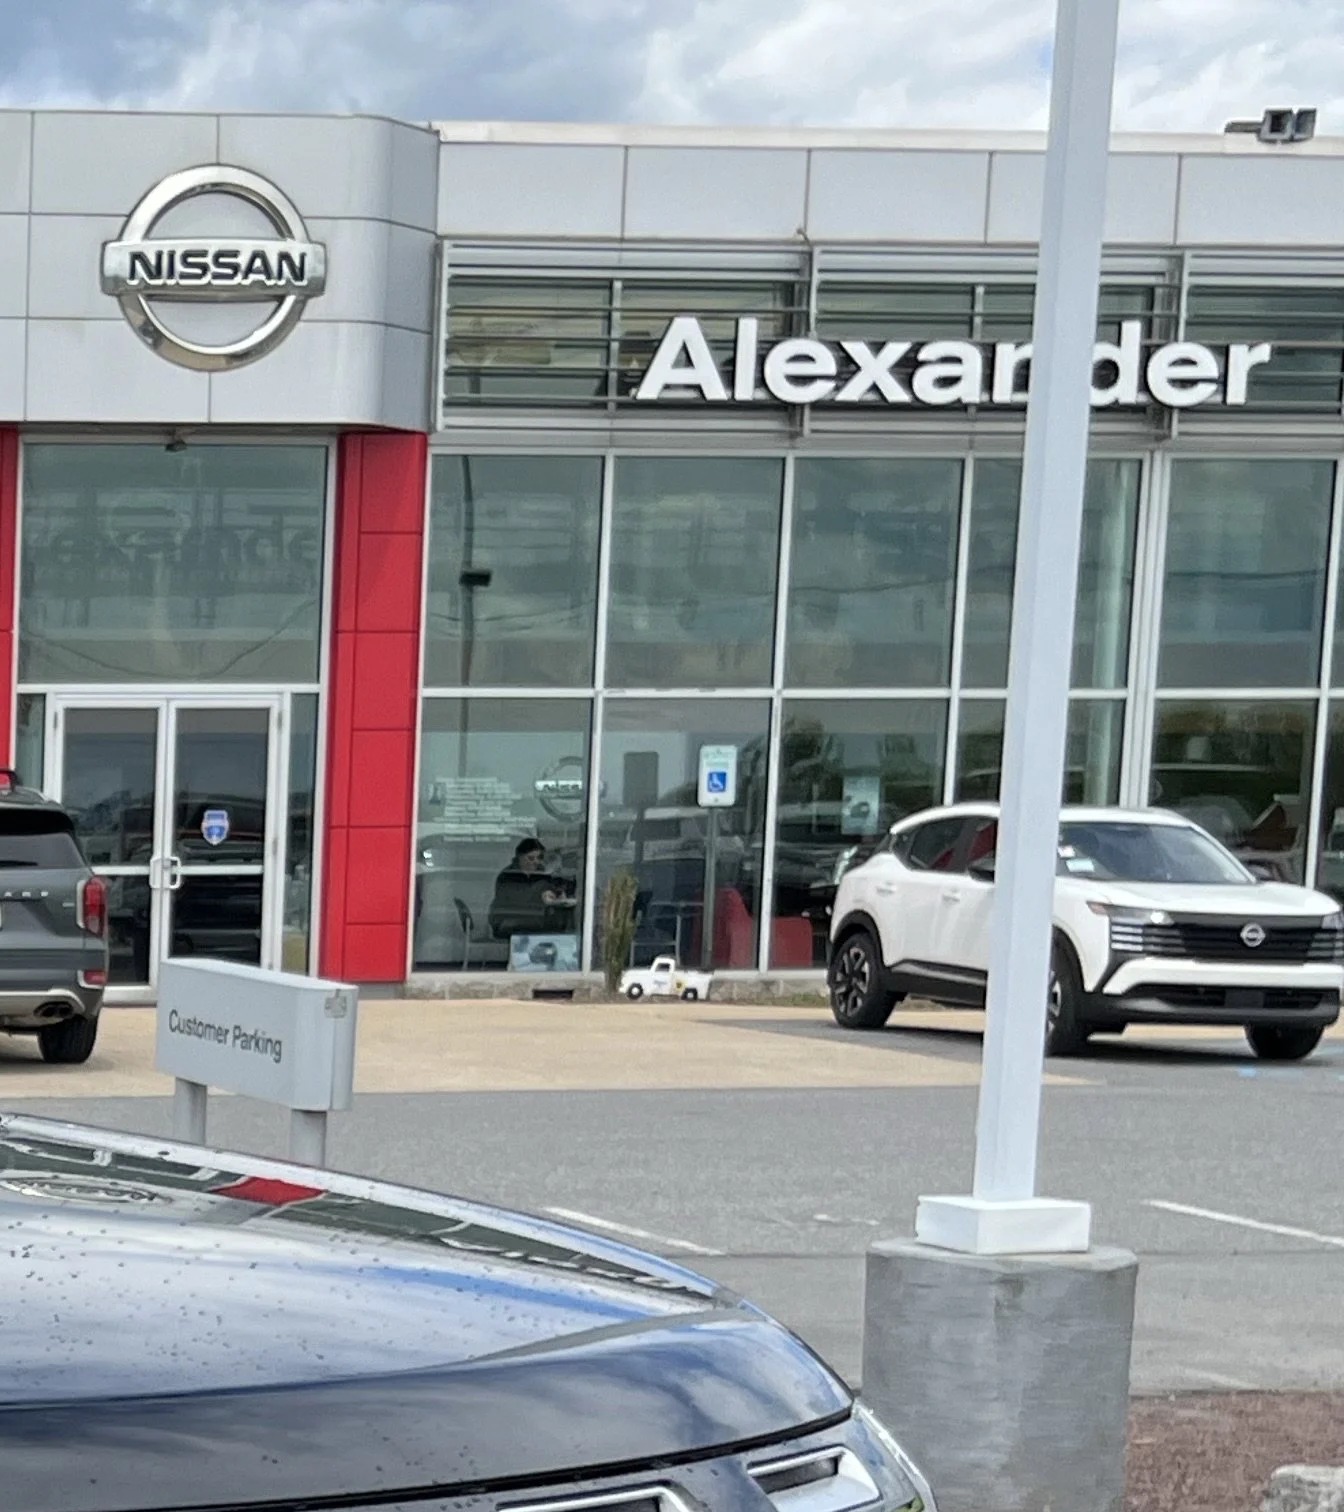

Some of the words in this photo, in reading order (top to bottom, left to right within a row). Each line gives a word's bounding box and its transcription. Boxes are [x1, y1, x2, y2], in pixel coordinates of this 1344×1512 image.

[127, 249, 308, 284] NISSAN
[168, 1008, 230, 1045] Customer
[231, 1024, 283, 1064] Parking
